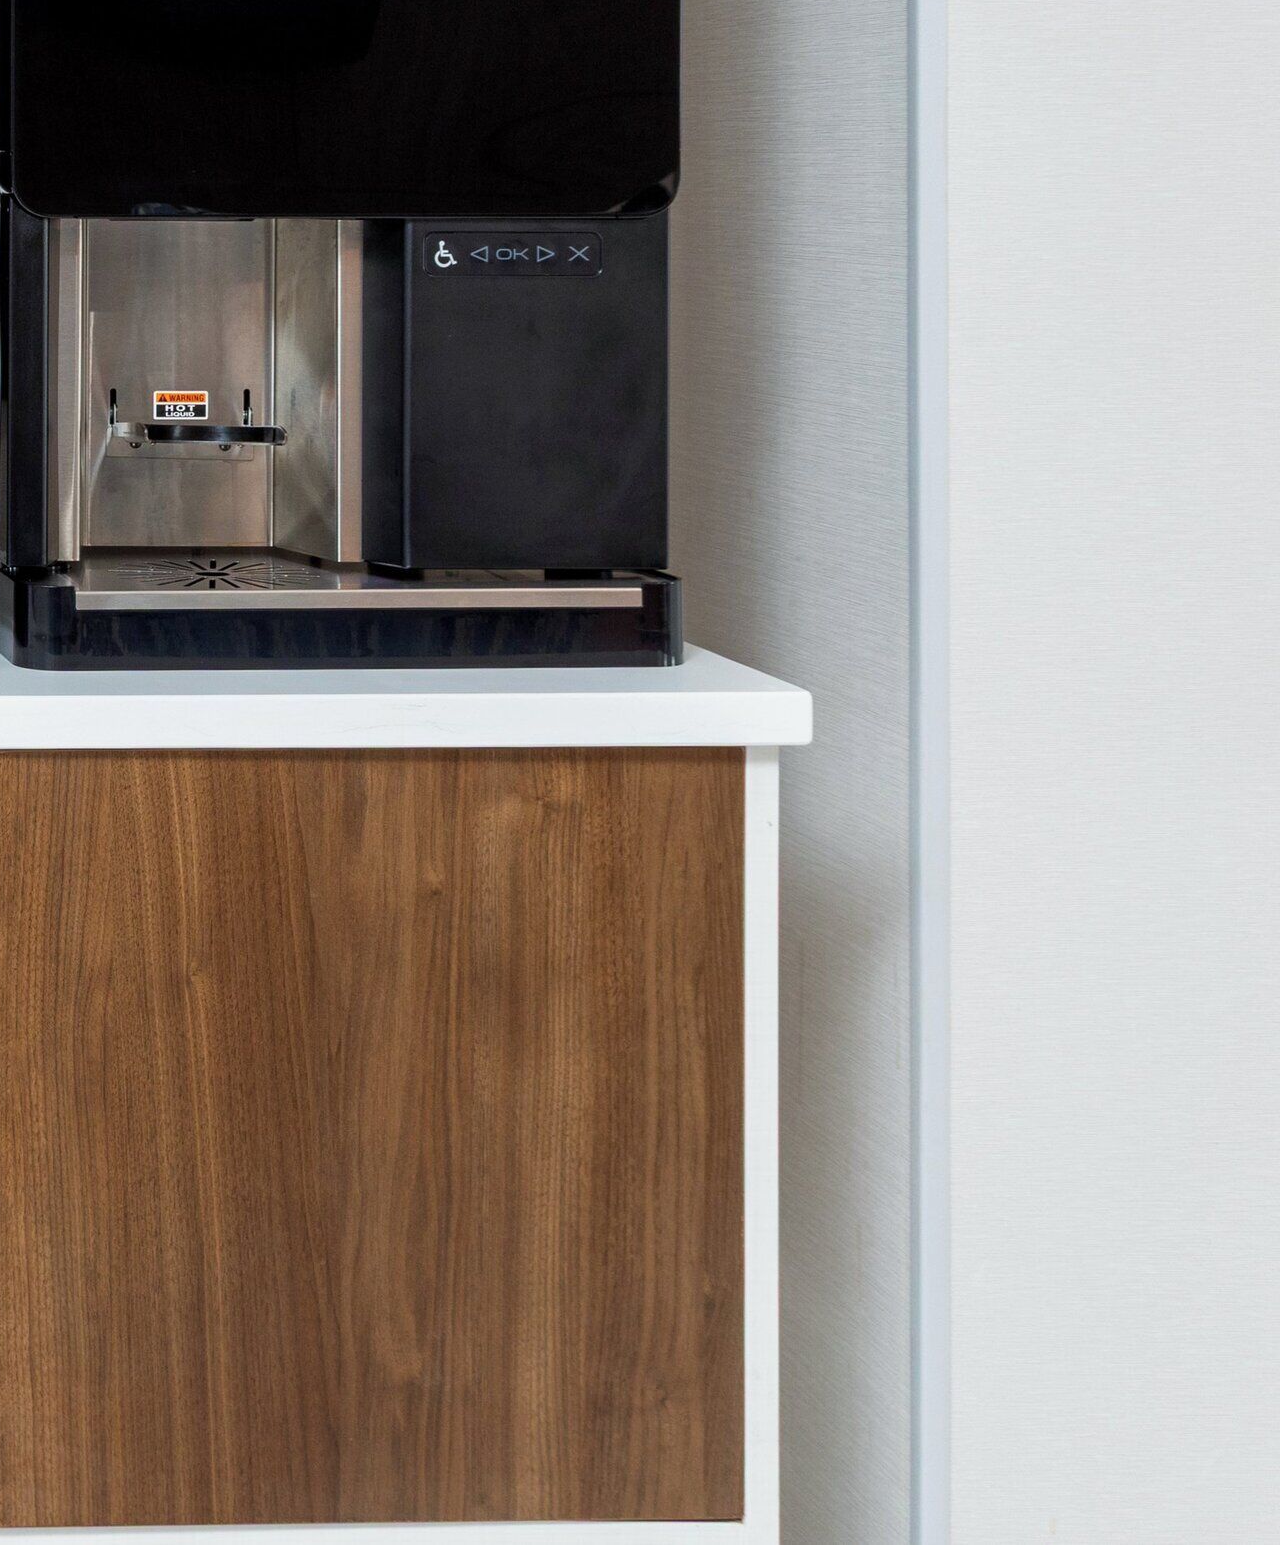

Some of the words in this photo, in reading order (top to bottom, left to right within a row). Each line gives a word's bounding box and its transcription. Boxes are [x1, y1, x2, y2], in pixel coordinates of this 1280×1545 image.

[495, 248, 529, 260] OK
[169, 394, 205, 402] WARNING
[165, 404, 196, 412] HOT
